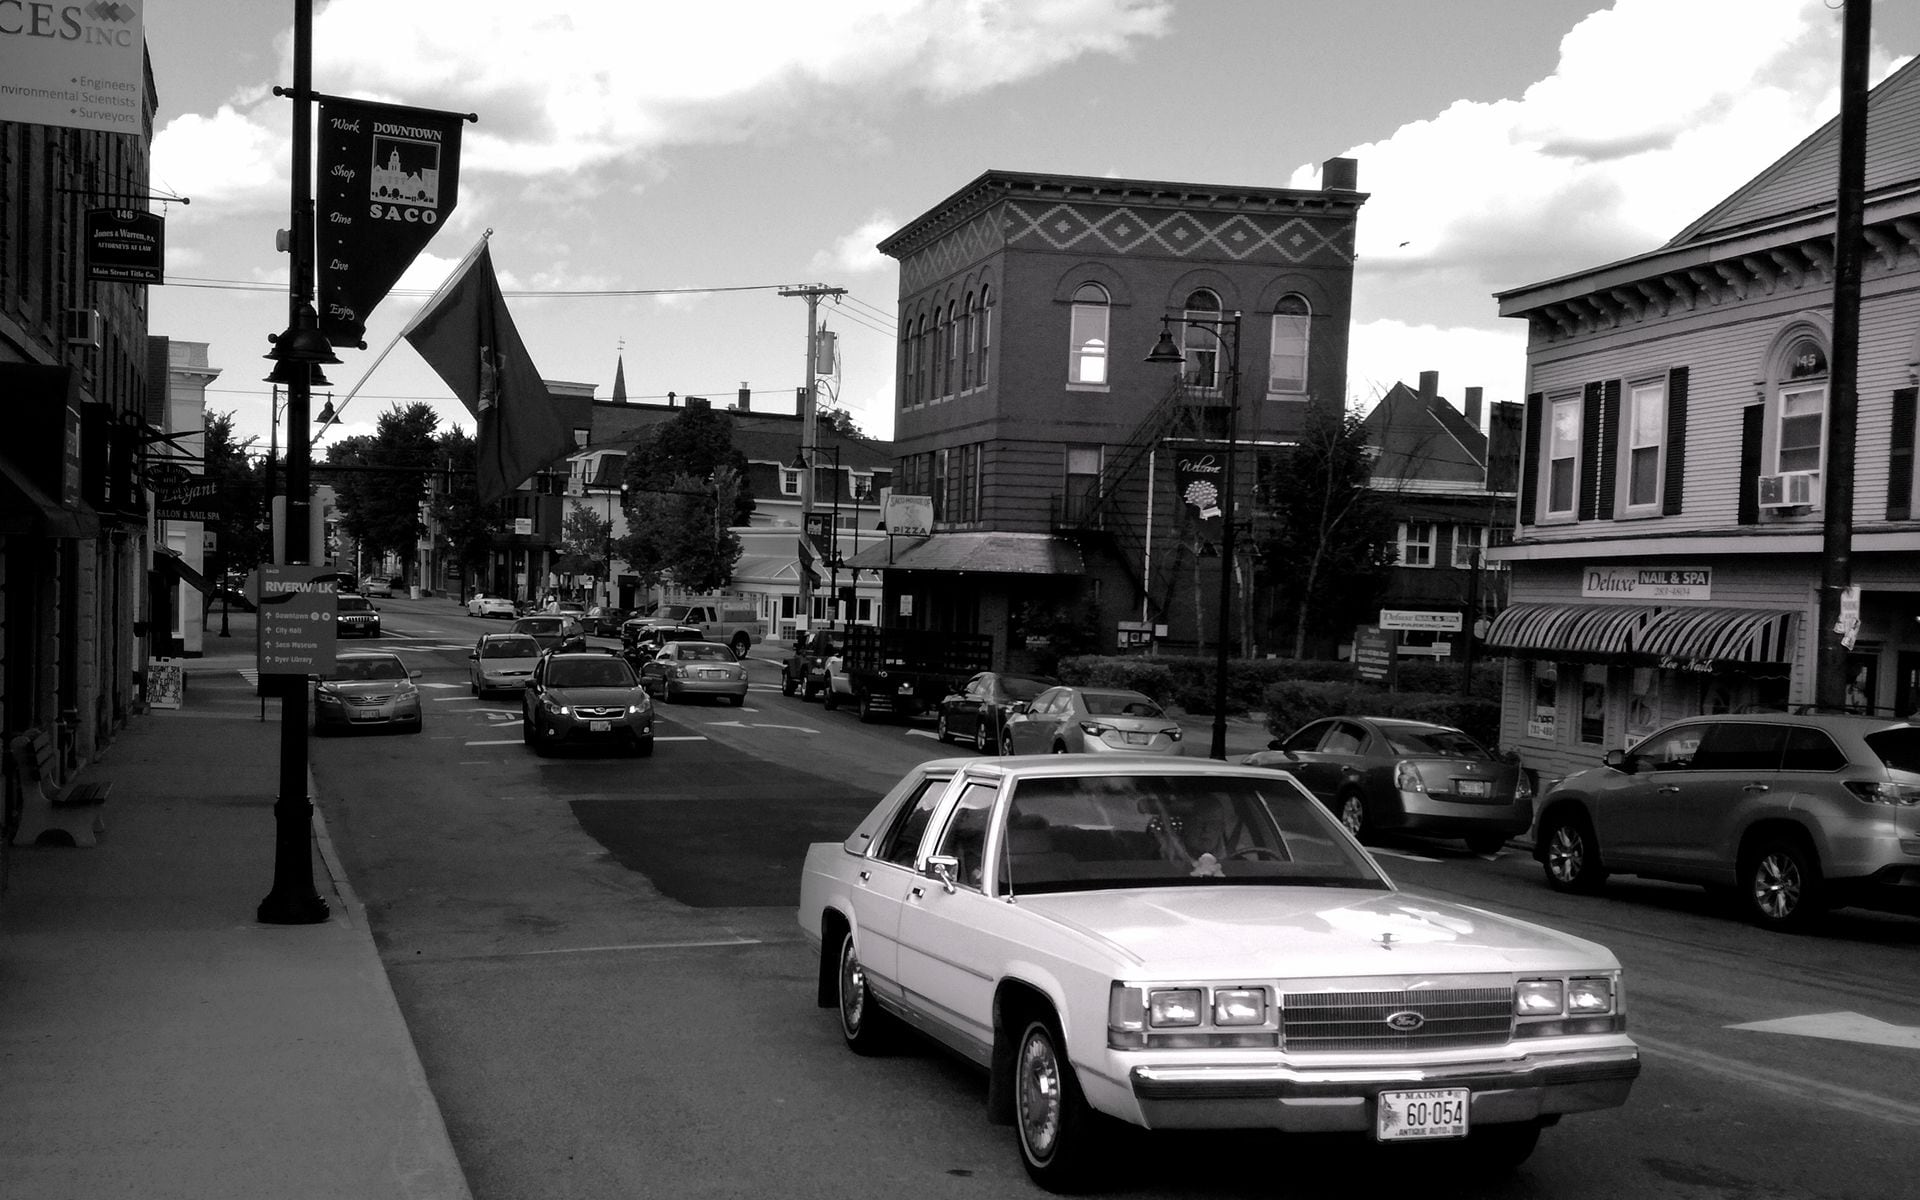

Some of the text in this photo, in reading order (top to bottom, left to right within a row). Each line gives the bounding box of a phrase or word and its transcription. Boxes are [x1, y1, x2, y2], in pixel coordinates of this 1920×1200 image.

[80, 76, 136, 92] Engineers
[81, 92, 136, 107] Scientists
[79, 107, 135, 123] Surveyors
[330, 118, 360, 134] Work
[373, 122, 442, 141] DOWNTOWN
[331, 164, 355, 183] Shop
[116, 209, 133, 219] 146
[330, 211, 352, 225] Dine
[370, 204, 437, 224] SACO
[330, 259, 349, 271] Live
[329, 303, 355, 321] Enjoy
[1179, 455, 1222, 473] Welcome
[156, 509, 181, 519] SALON
[190, 511, 206, 520] NAIL
[207, 511, 220, 520] SPA
[893, 526, 927, 536] PIZZA
[265, 581, 334, 594] RIVERWALK
[1587, 569, 1707, 592] Deluxe NAIL & SPA
[275, 627, 288, 635] City
[1682, 658, 1713, 672] Nails
[1405, 1091, 1444, 1100] MAINE
[1398, 1127, 1427, 1136] ANTIQUE
